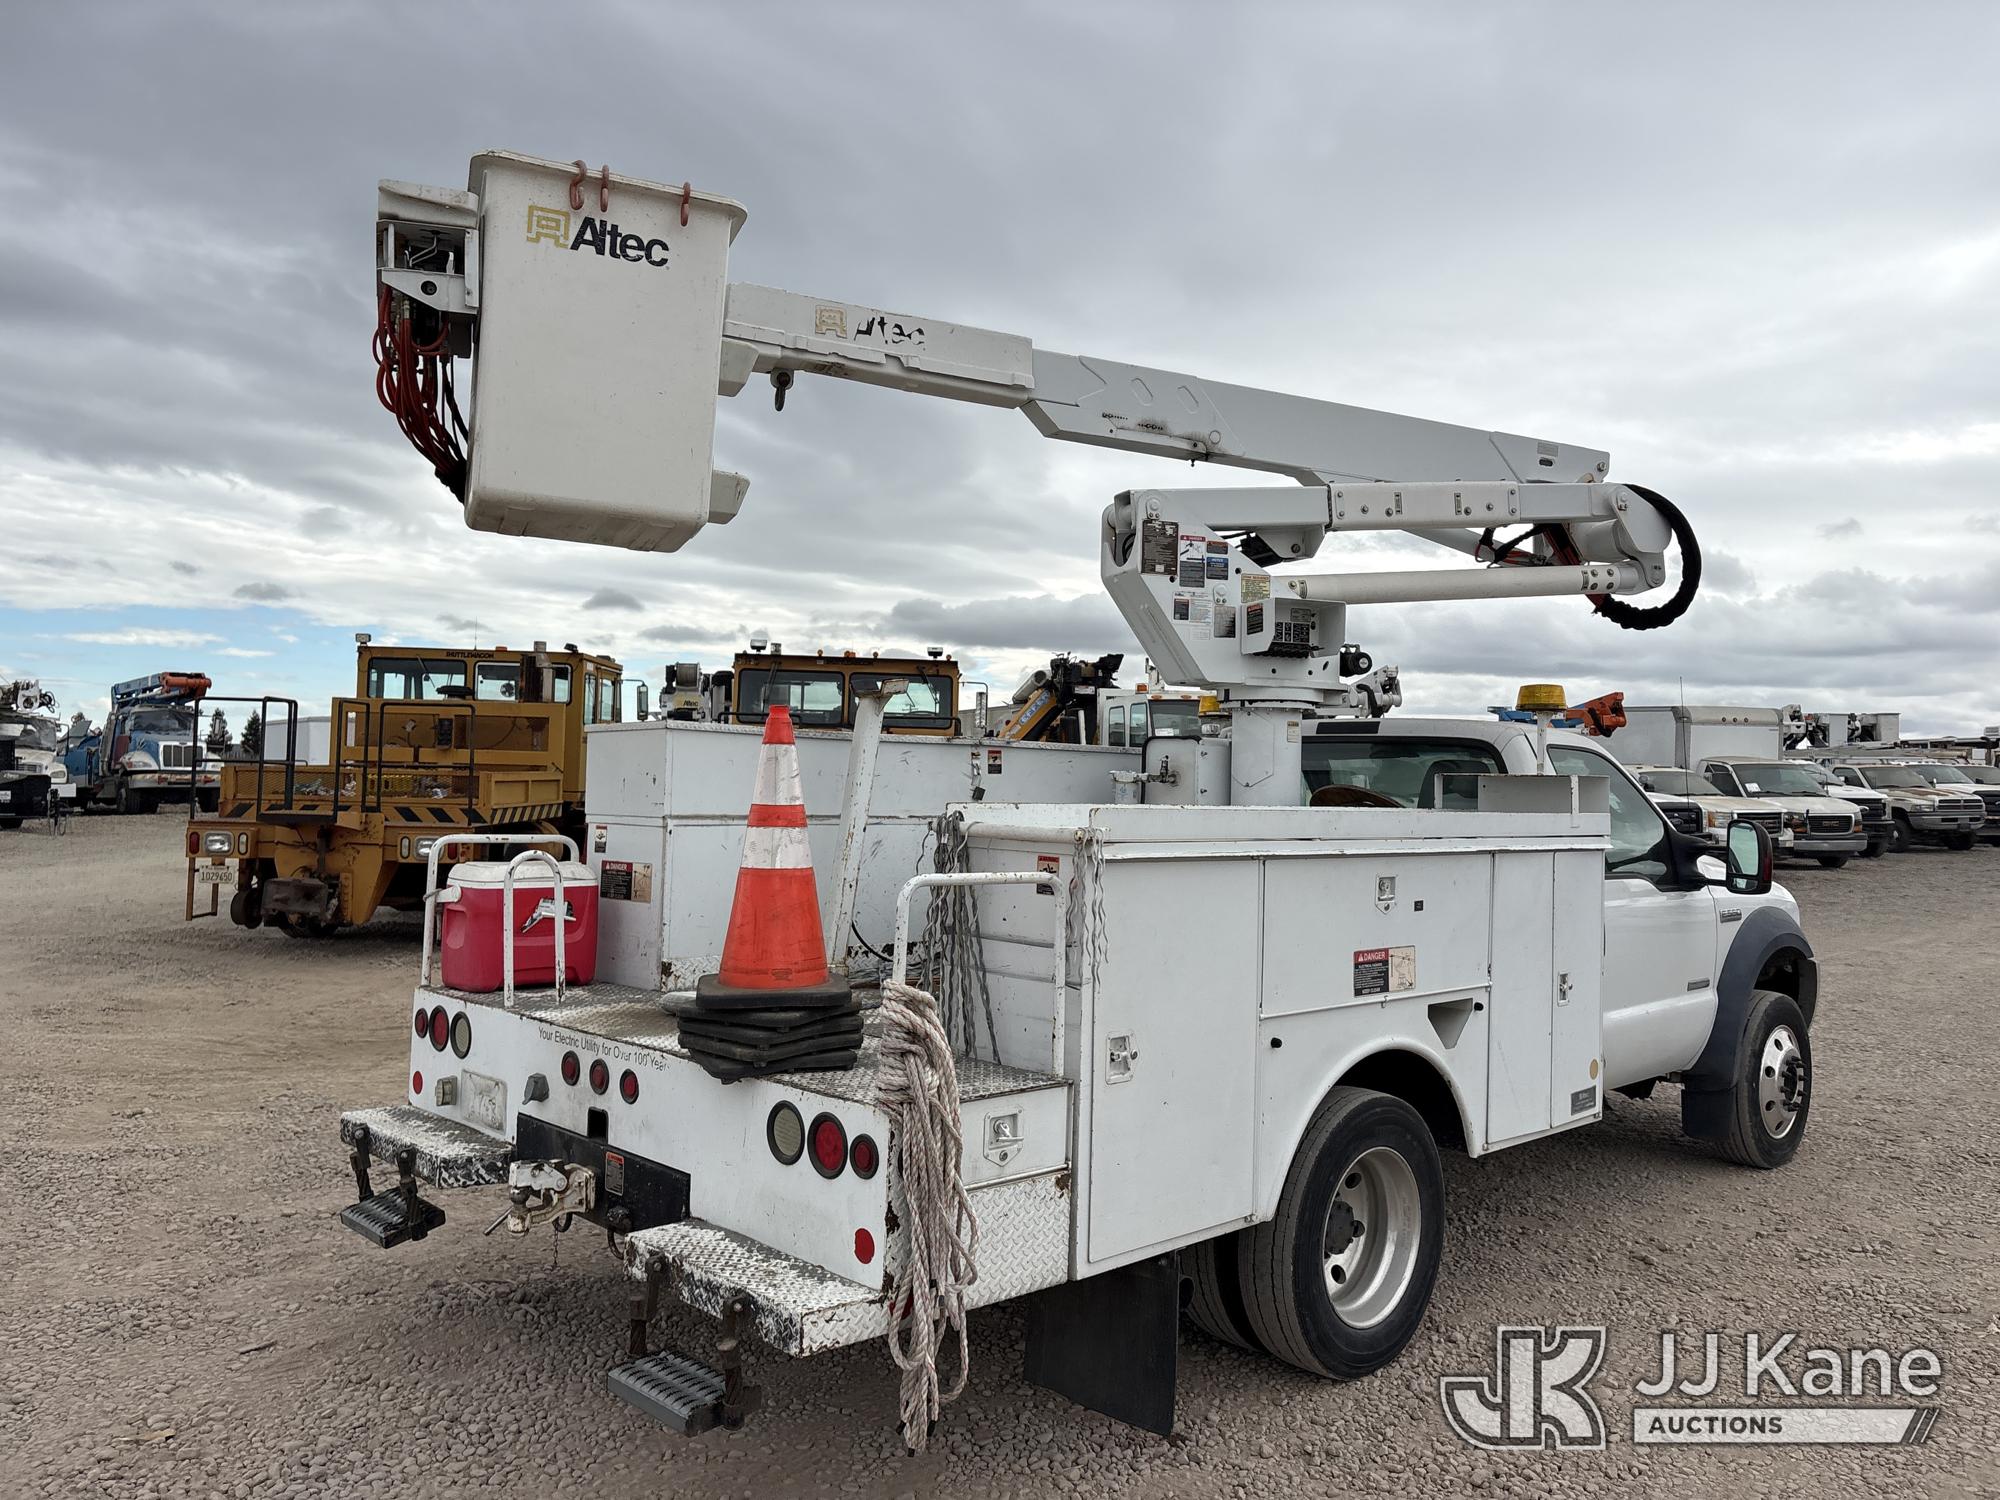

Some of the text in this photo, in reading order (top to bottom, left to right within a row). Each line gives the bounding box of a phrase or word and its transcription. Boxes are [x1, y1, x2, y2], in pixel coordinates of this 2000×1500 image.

[570, 216, 669, 267] Altec
[610, 862, 628, 870] DANGER
[1363, 951, 1385, 961] DANGER
[538, 1026, 553, 1039] Your
[554, 1031, 579, 1048] Electric
[581, 1038, 600, 1056] Utility
[601, 1042, 611, 1055] for
[634, 1052, 647, 1066] 100
